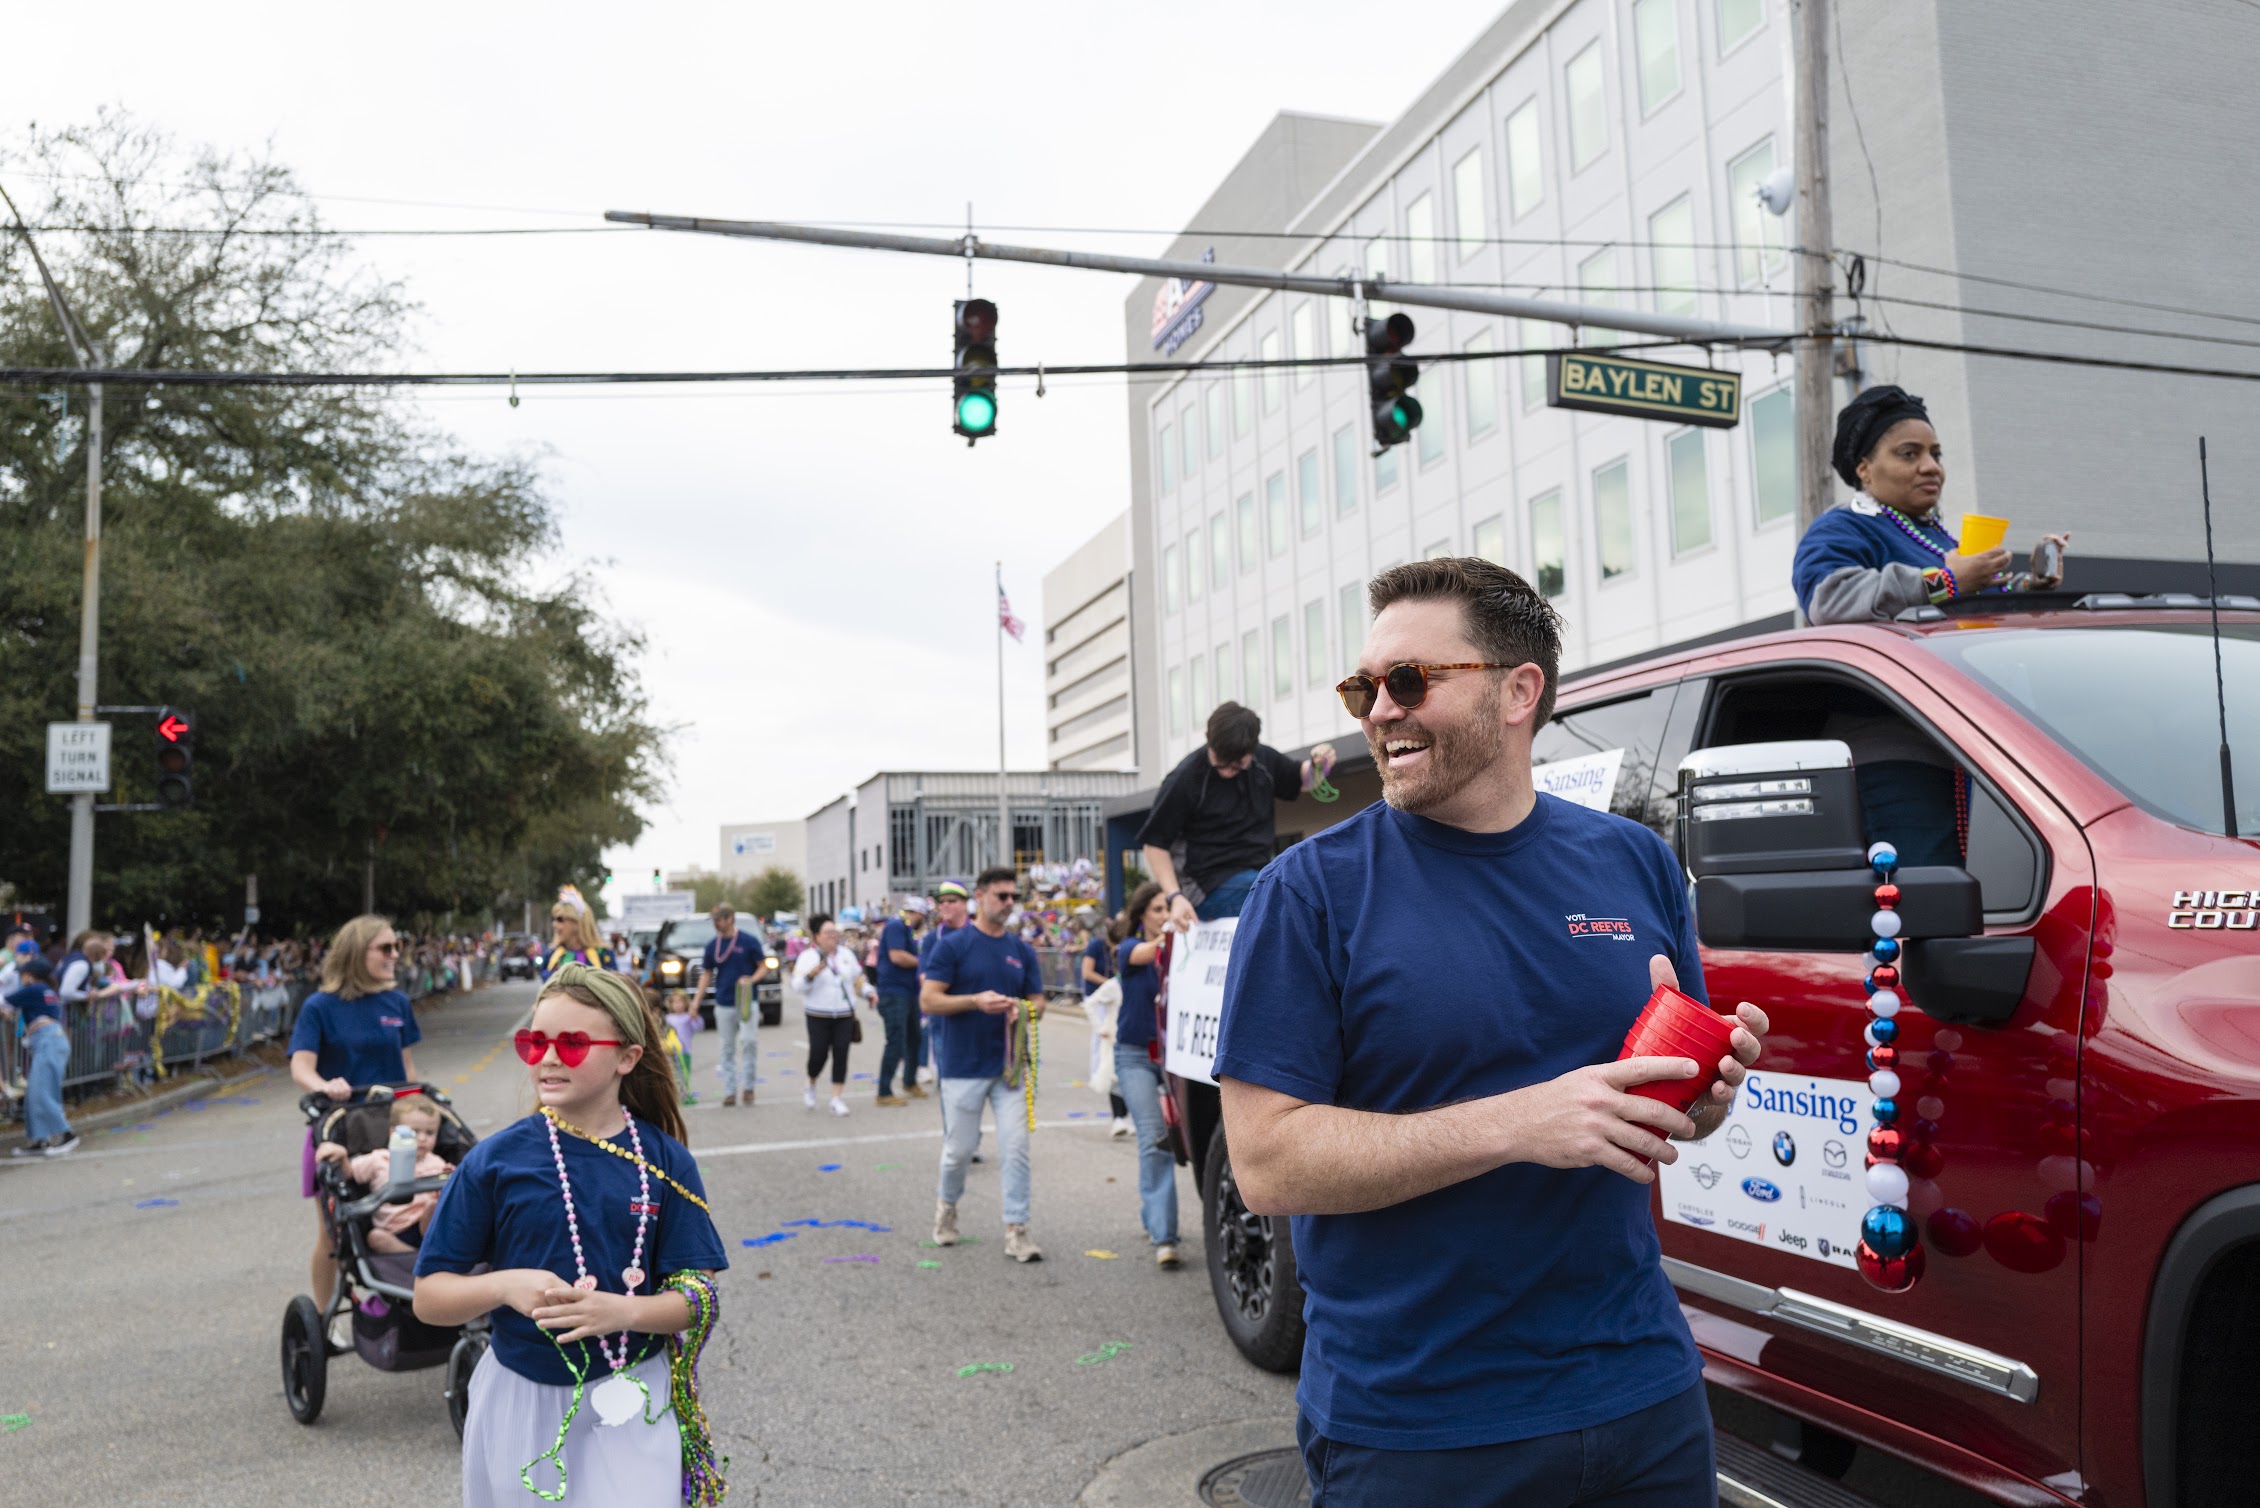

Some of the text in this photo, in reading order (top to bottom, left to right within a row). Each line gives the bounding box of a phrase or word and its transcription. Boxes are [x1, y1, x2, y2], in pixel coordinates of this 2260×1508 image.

[1566, 362, 1735, 410] BAYLEN ST
[62, 730, 95, 746] LEFT
[61, 750, 97, 765] TURN
[53, 769, 104, 785] SIGNAL
[1544, 763, 1607, 794] Sansing
[1565, 913, 1587, 922] VOTE
[1568, 921, 1632, 935] DC REEVES
[1612, 933, 1636, 942] MAYOR
[1191, 1013, 1218, 1060] REE
[1746, 1075, 1858, 1135] Sansing
[1748, 1178, 1775, 1200] Ford
[1678, 1202, 1714, 1217] CHRYSLER
[1727, 1218, 1761, 1235] DODGE
[1778, 1228, 1807, 1250] Jeep
[1832, 1245, 1857, 1258] RA
